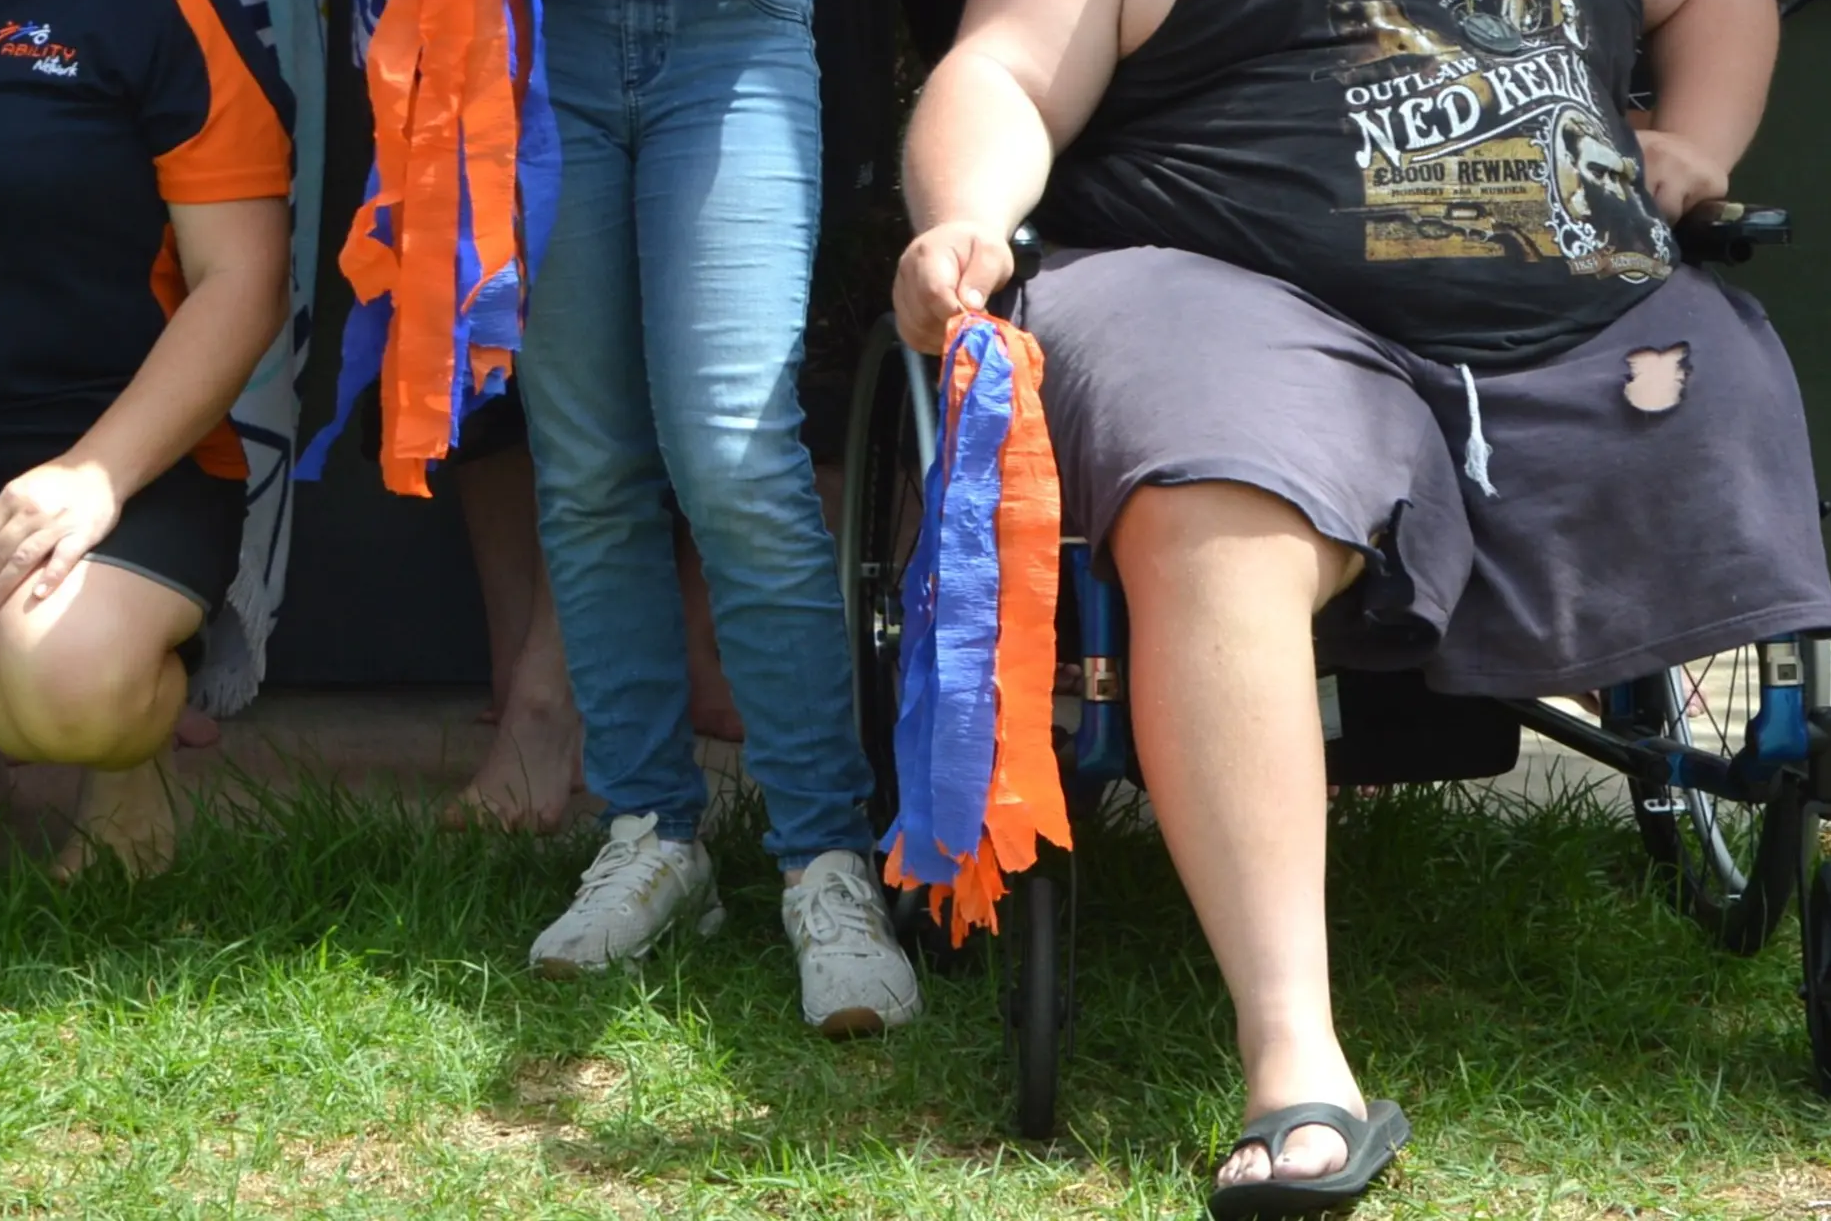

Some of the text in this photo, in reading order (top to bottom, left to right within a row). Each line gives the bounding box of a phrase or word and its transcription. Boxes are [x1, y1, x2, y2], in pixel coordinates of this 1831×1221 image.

[0, 42, 77, 60] ABILITY
[1345, 57, 1478, 106] OUTLAW
[1349, 51, 1601, 170] NED KELLY
